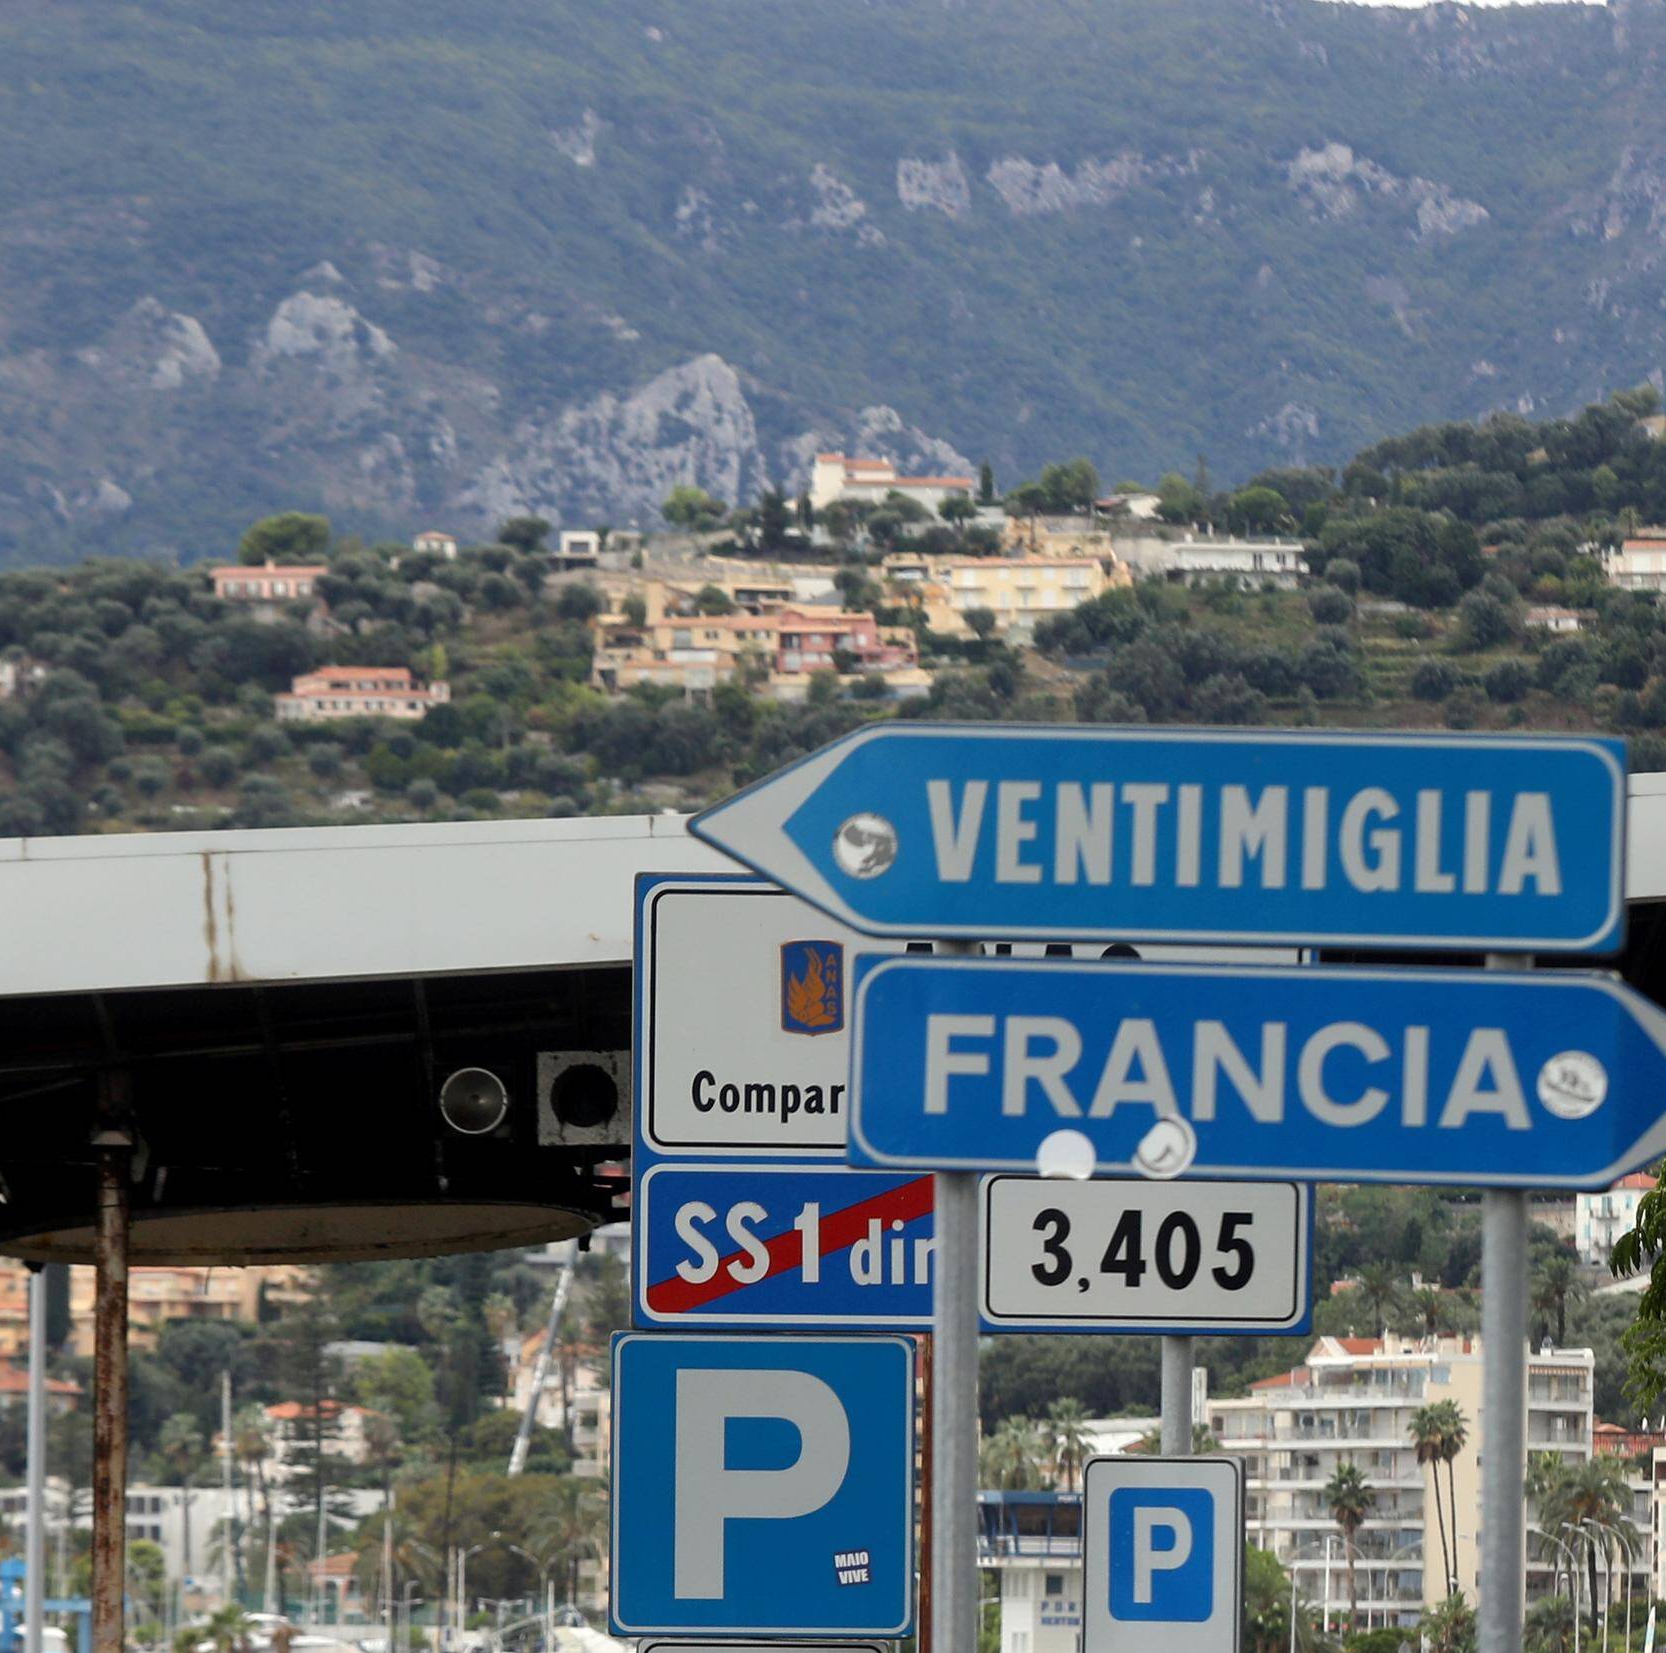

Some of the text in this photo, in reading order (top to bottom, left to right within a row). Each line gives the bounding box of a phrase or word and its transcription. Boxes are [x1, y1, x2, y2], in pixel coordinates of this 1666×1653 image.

[926, 779, 1563, 896] VENTIMIGLIA
[690, 1069, 846, 1125] Compar
[923, 1013, 1533, 1131] FRANCIA
[673, 1200, 937, 1286] SS 1 dir
[1030, 1206, 1256, 1294] 3,405
[673, 1368, 852, 1600] P
[837, 1568, 870, 1584] VIVE
[1133, 1505, 1194, 1604] P
